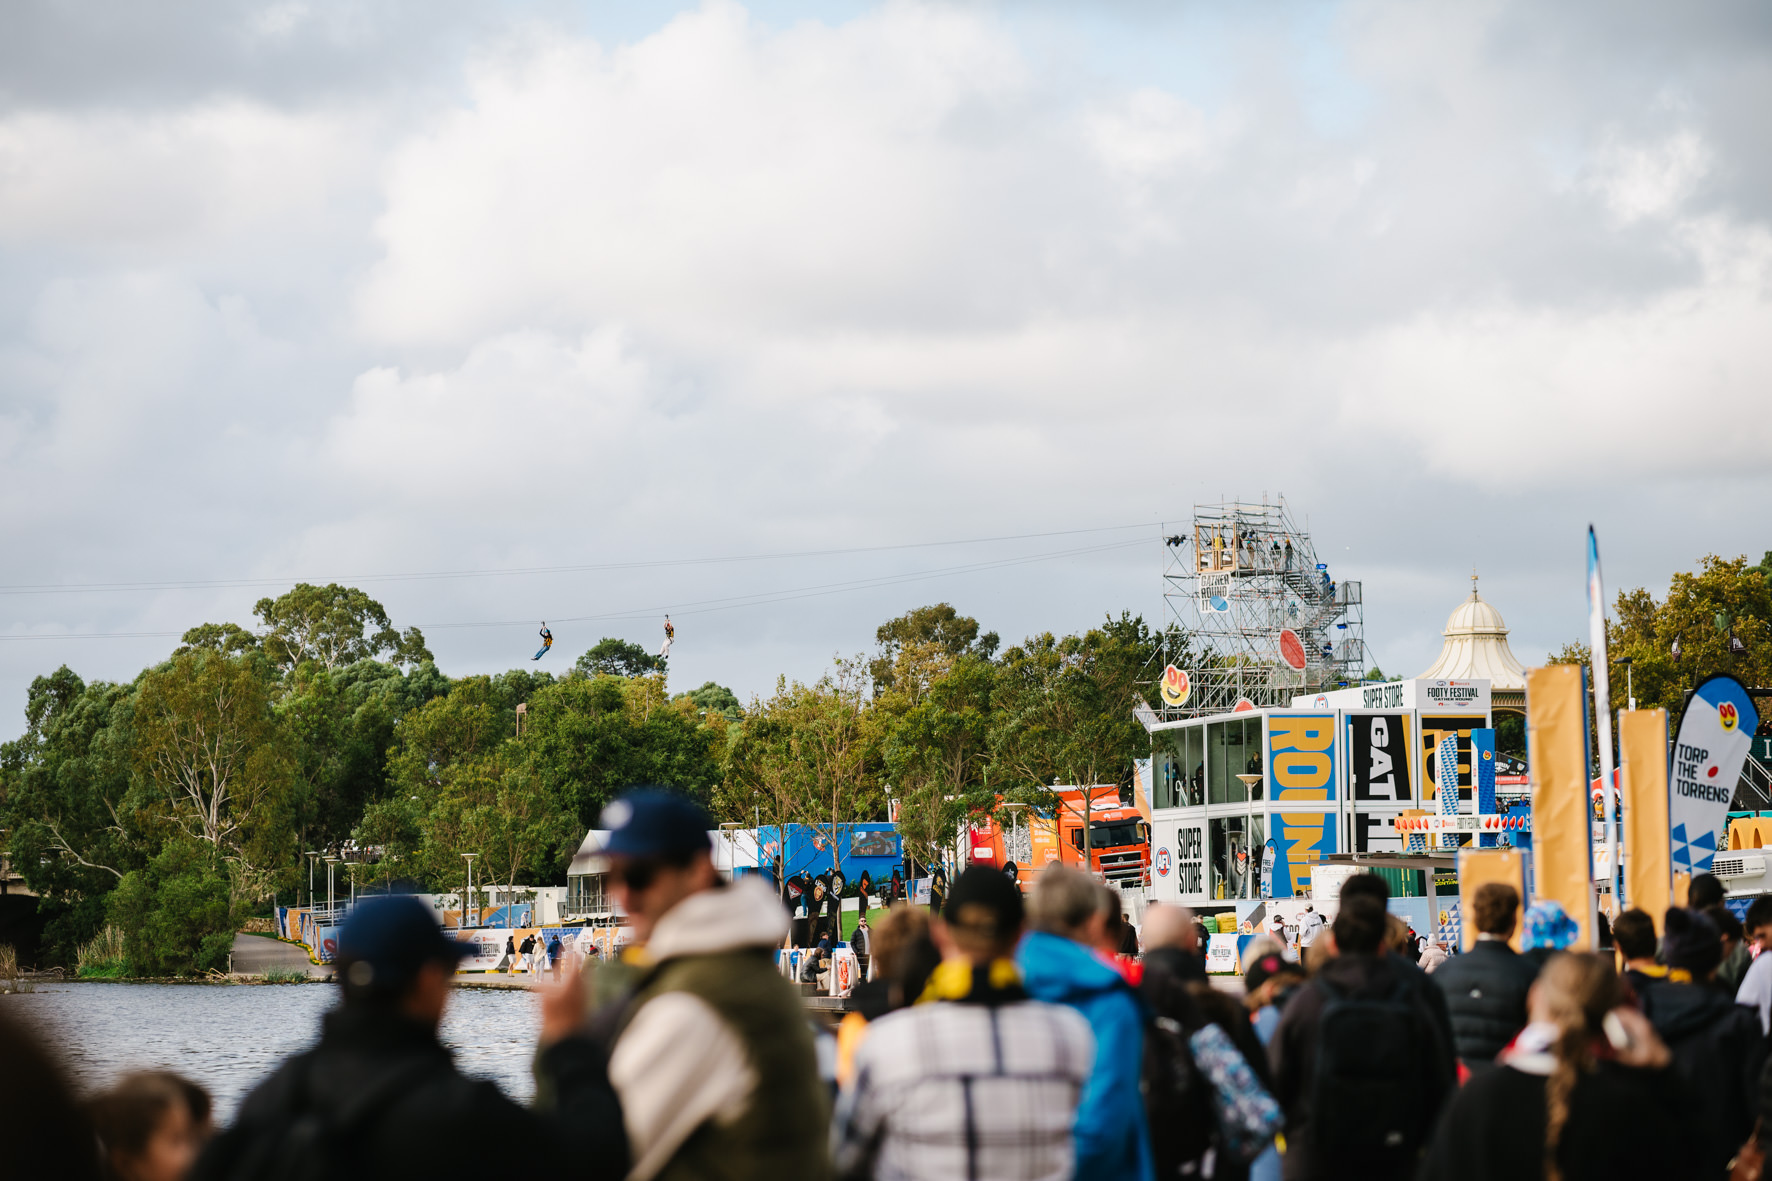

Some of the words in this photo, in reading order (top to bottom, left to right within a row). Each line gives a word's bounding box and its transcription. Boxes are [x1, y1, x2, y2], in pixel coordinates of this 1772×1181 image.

[1201, 574, 1229, 586] GATHER
[1201, 586, 1227, 598] ROUND
[1202, 599, 1211, 611] IT!
[1363, 686, 1383, 708] SUPER
[1384, 684, 1404, 707] STORE
[1428, 688, 1448, 697] FOOTY
[1450, 688, 1478, 697] FESTIVAL
[1679, 743, 1708, 765] TORP
[1677, 761, 1697, 780] THE
[1367, 717, 1404, 852] GATH
[1676, 778, 1729, 804] TORRENS
[1269, 718, 1335, 896] ROUND
[1457, 818, 1467, 829] FOOTY
[1178, 827, 1202, 859] SUPER
[1157, 854, 1171, 871] AFL
[1179, 862, 1202, 894] STORE
[483, 943, 501, 954] FESTIVAL
